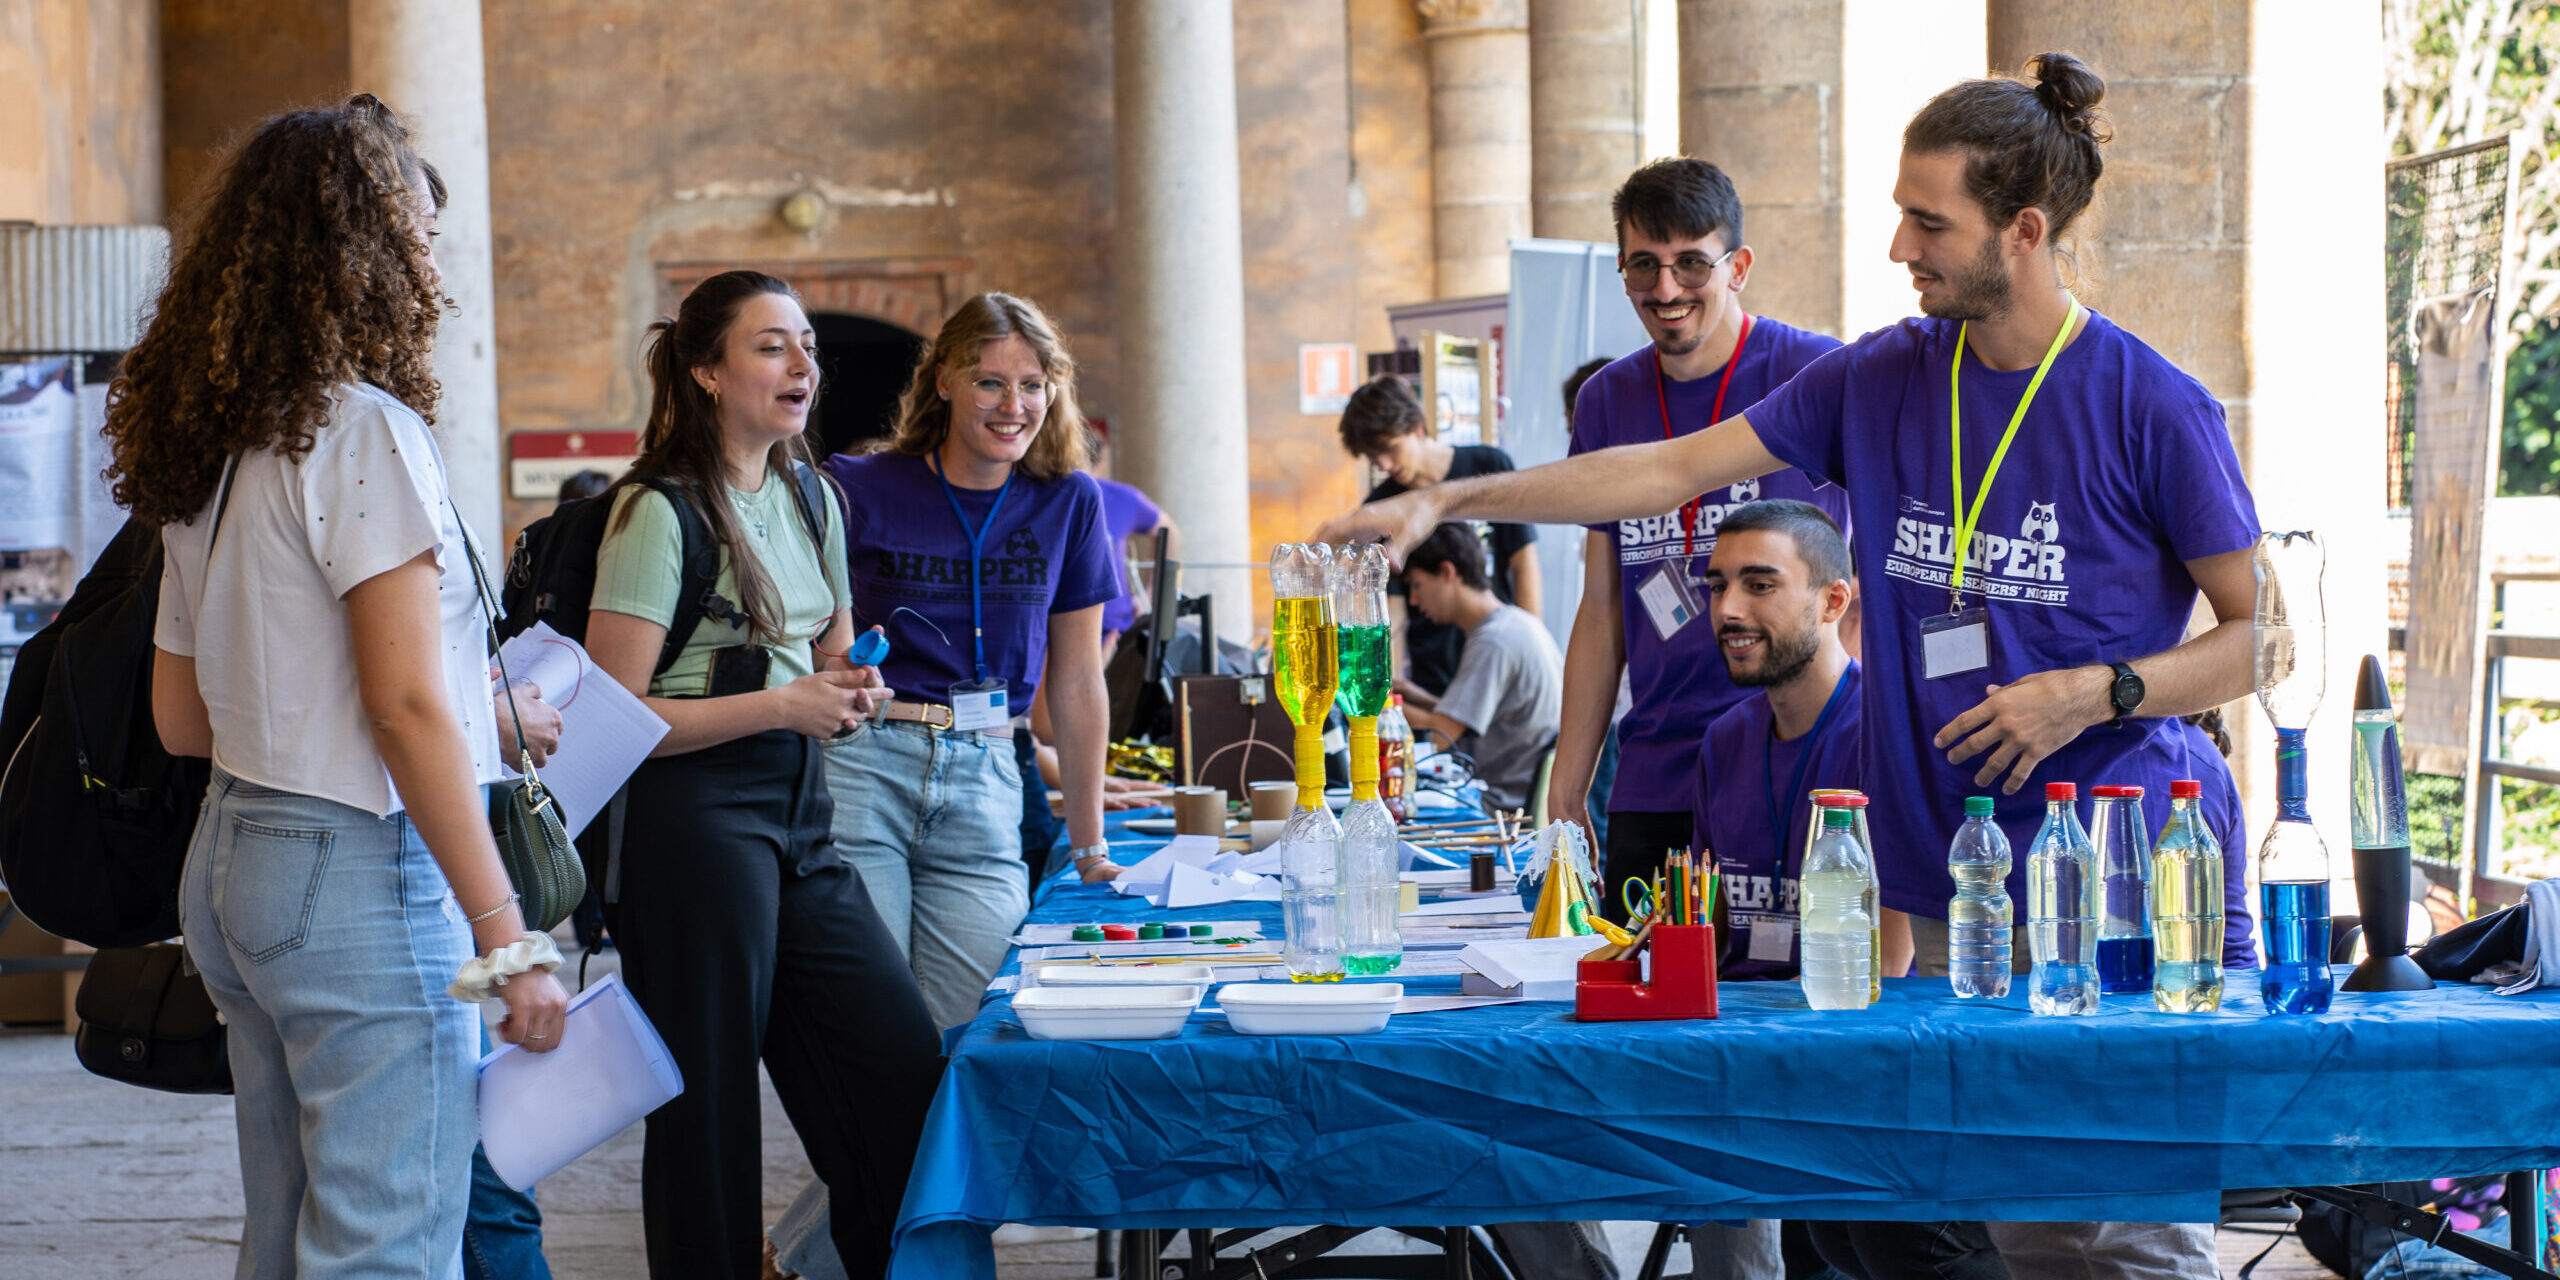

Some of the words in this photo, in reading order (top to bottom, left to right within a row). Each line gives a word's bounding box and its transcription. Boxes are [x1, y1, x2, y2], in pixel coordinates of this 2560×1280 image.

[876, 549, 1047, 585] SHARPER
[1885, 558, 1948, 584] EUROPEAN
[2024, 587, 2068, 602] NIGHT
